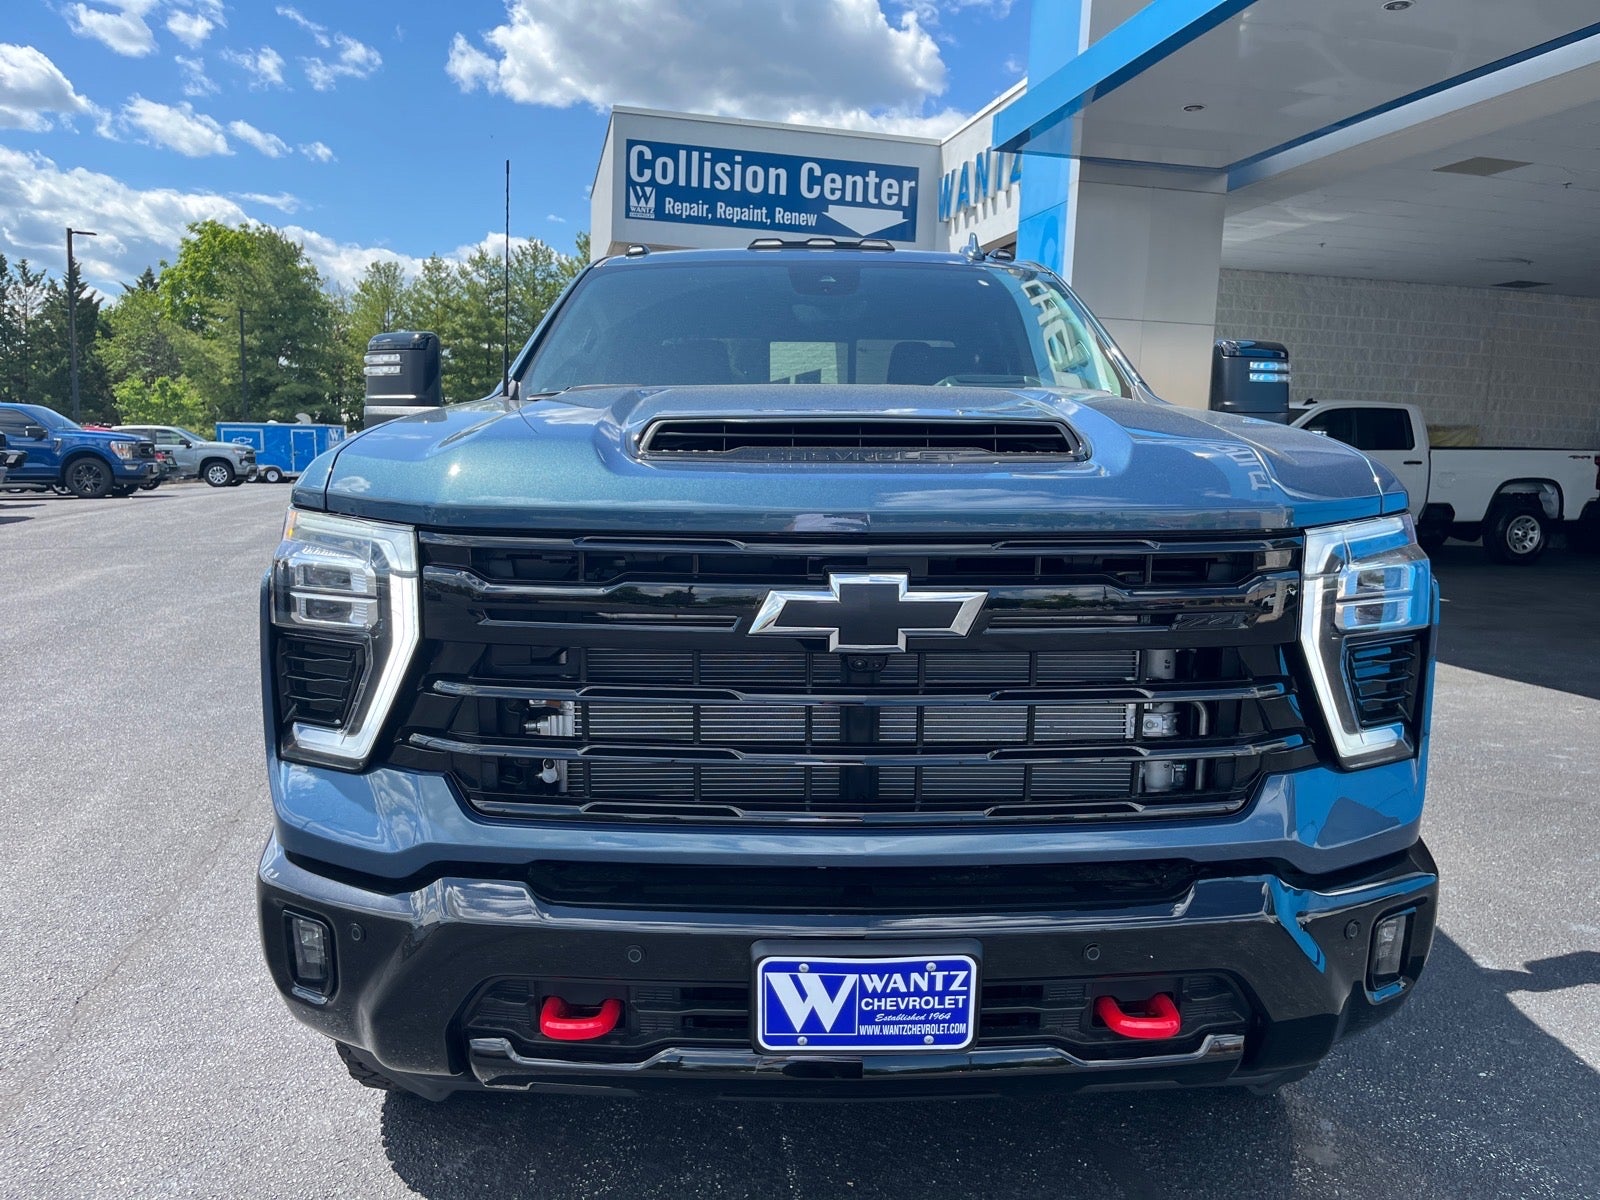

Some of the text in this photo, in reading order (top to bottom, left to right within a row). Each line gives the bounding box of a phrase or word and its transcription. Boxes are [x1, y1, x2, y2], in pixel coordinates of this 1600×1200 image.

[629, 144, 916, 207] Collision Center
[630, 206, 655, 214] WANTZ
[664, 197, 818, 227] Repair, Repaint, Renew
[861, 970, 969, 994] WANTZ
[766, 972, 859, 1034] W
[861, 995, 967, 1011] CHEVROLET
[875, 1012, 952, 1022] Established 1964
[859, 1022, 967, 1036] WWW.WANTZCHEVROLET.COM
